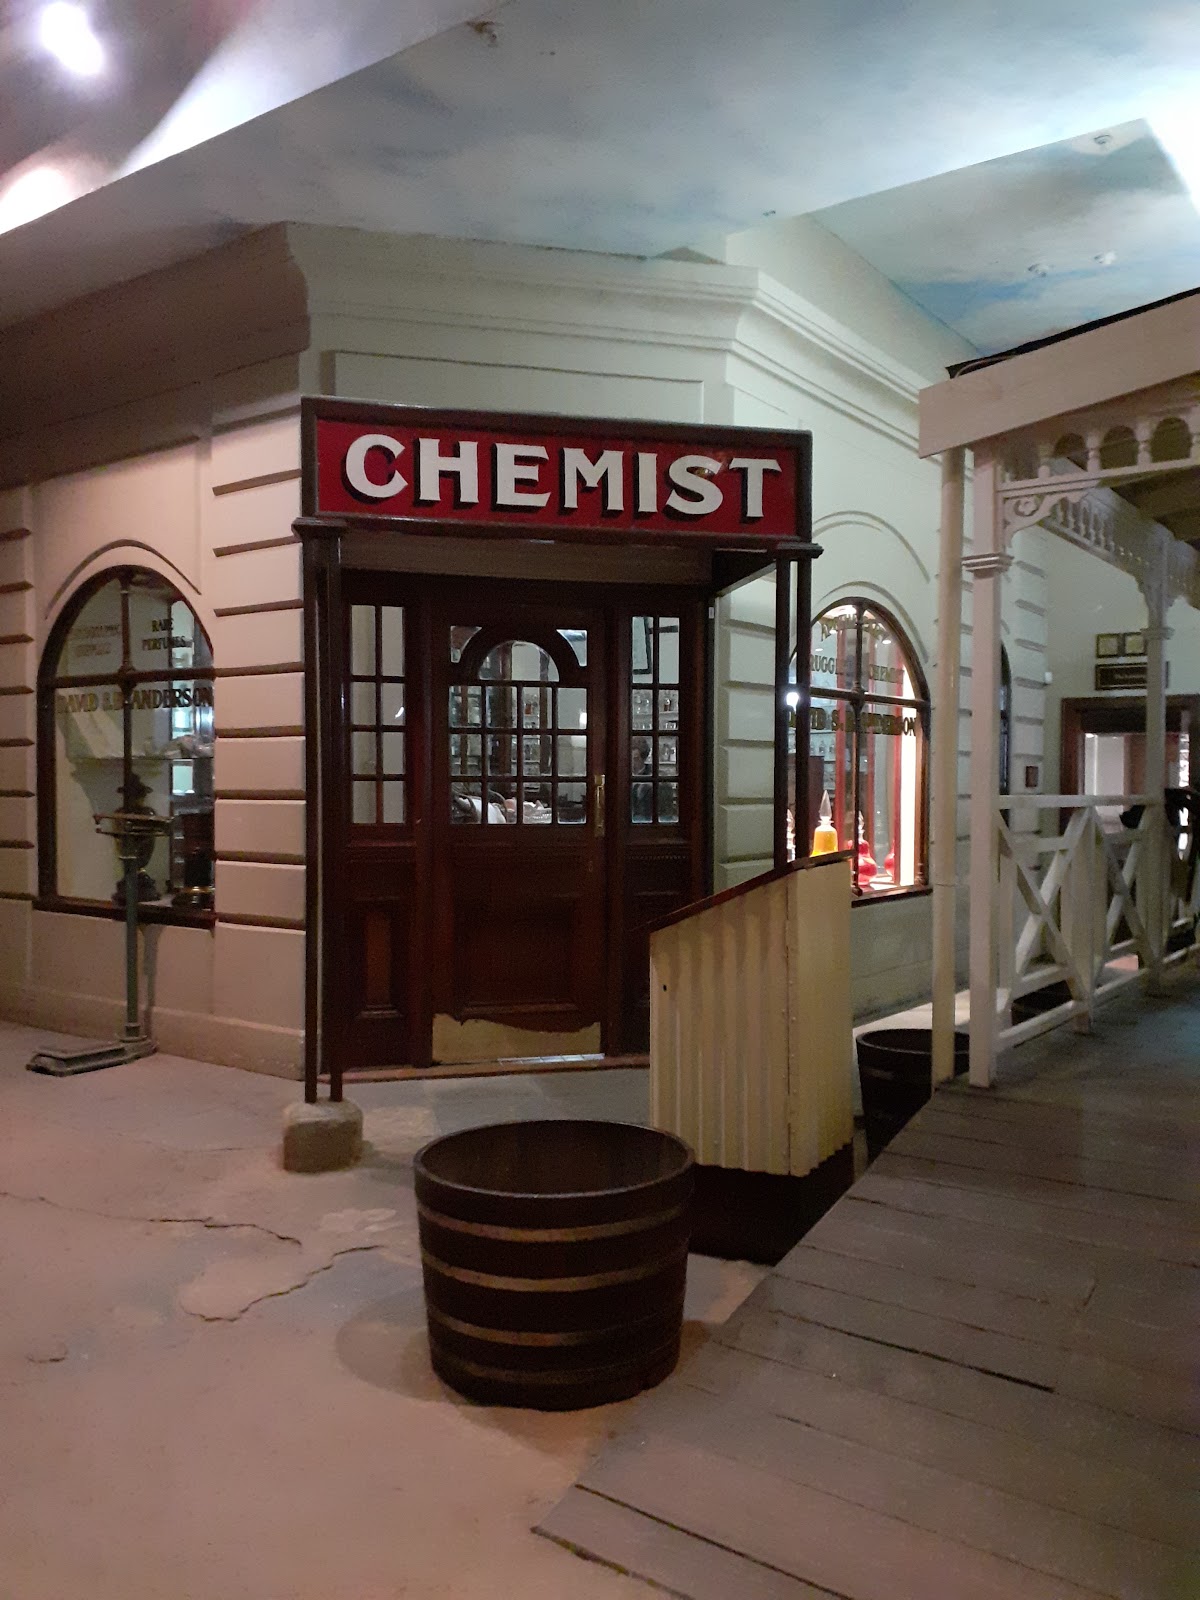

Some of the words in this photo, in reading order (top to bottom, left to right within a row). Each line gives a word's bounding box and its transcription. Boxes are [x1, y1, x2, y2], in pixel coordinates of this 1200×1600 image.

[343, 432, 783, 518] CHEMIST
[151, 618, 174, 632] RARE
[56, 692, 98, 714] DAVID
[131, 687, 214, 709] ANDERSON
[788, 704, 826, 731] DID
